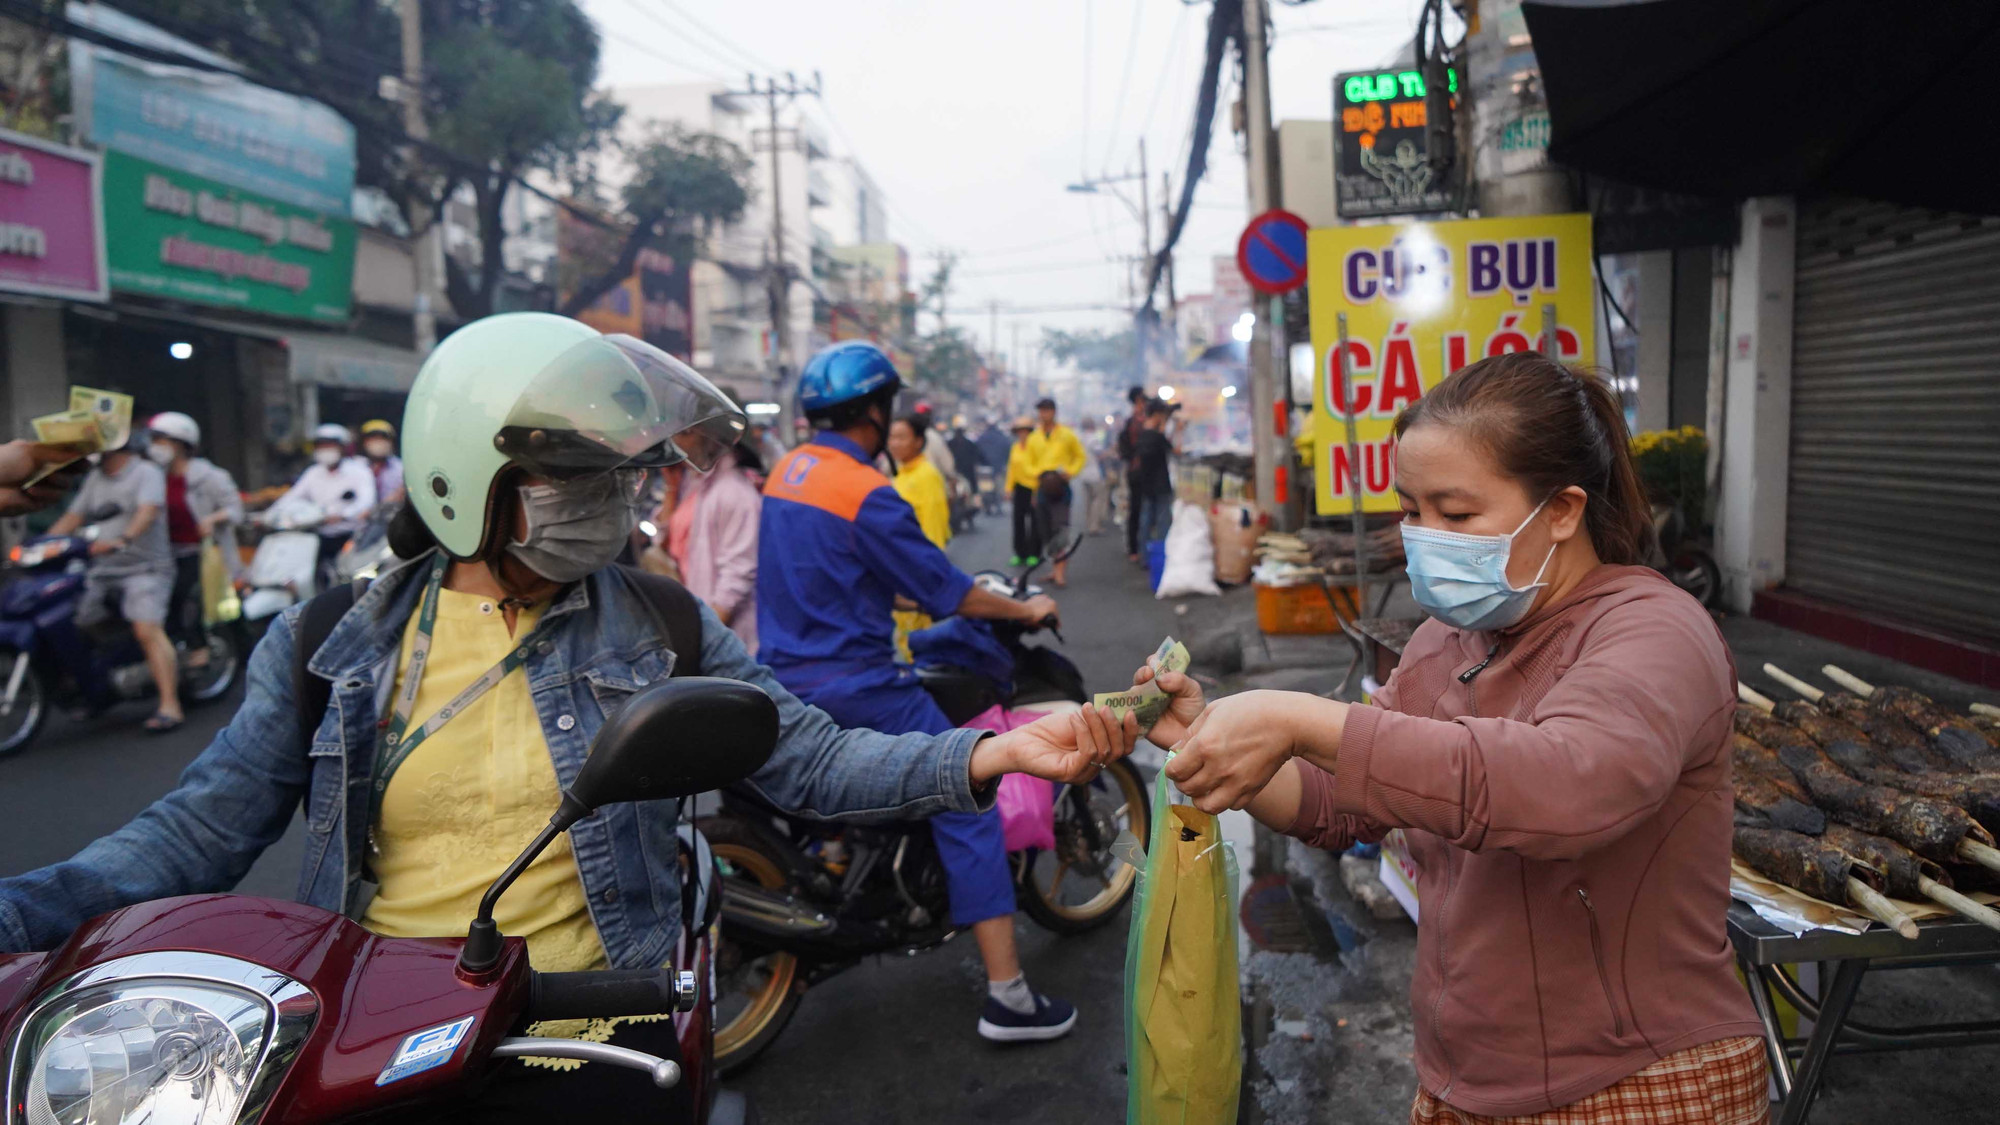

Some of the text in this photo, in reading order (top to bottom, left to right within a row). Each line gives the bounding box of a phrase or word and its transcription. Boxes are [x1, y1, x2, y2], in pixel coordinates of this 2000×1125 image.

[1344, 74, 1398, 102] CLB
[1471, 239, 1556, 301] BỤI
[1330, 322, 1423, 415] CÁ
[406, 1023, 464, 1053] FI
